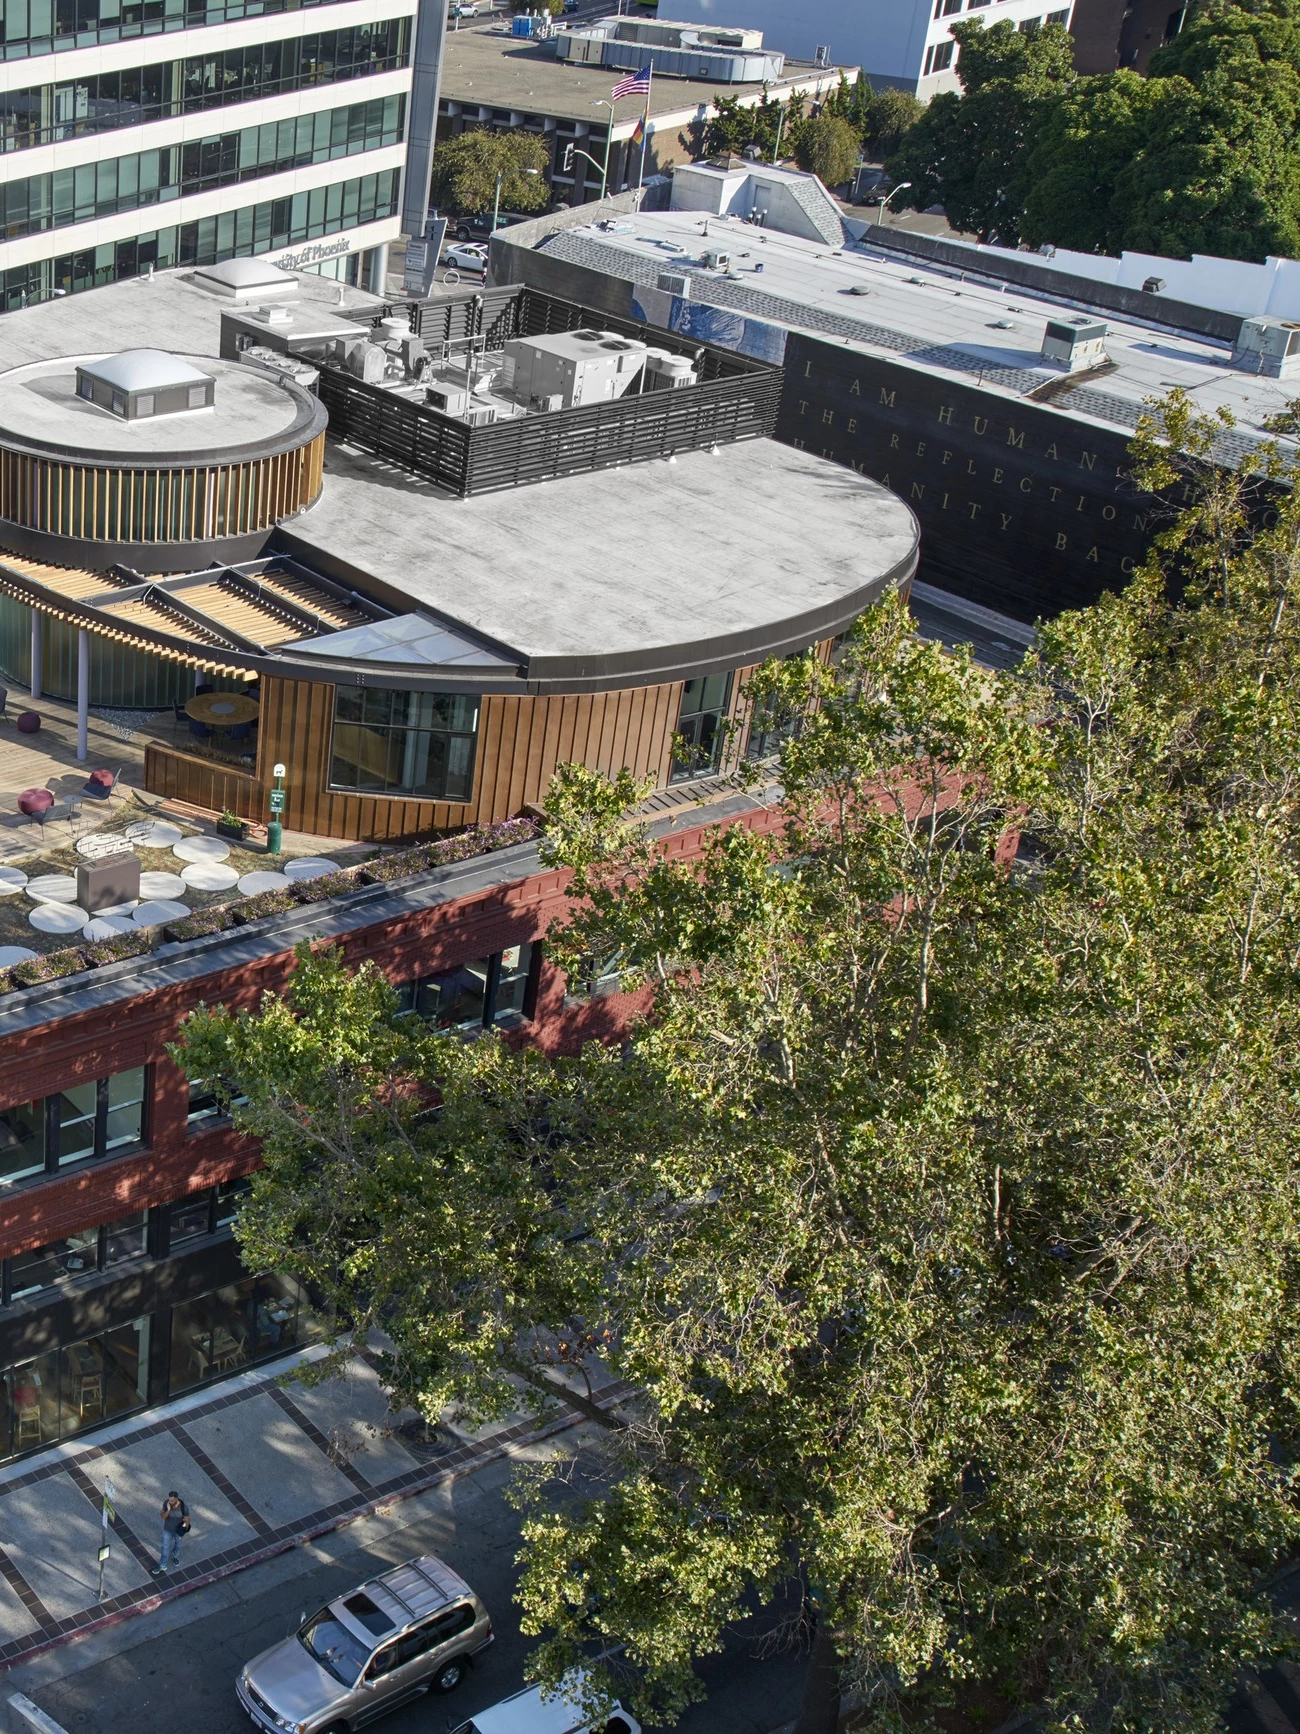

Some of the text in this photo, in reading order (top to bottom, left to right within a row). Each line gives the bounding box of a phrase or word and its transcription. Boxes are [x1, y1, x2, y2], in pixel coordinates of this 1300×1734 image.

[312, 238, 351, 260] Phoenix
[803, 360, 1098, 471] I AM HUMAN
[798, 399, 858, 434] THE
[889, 433, 1150, 532] REFLECTION
[1054, 532, 1135, 574] BAC
